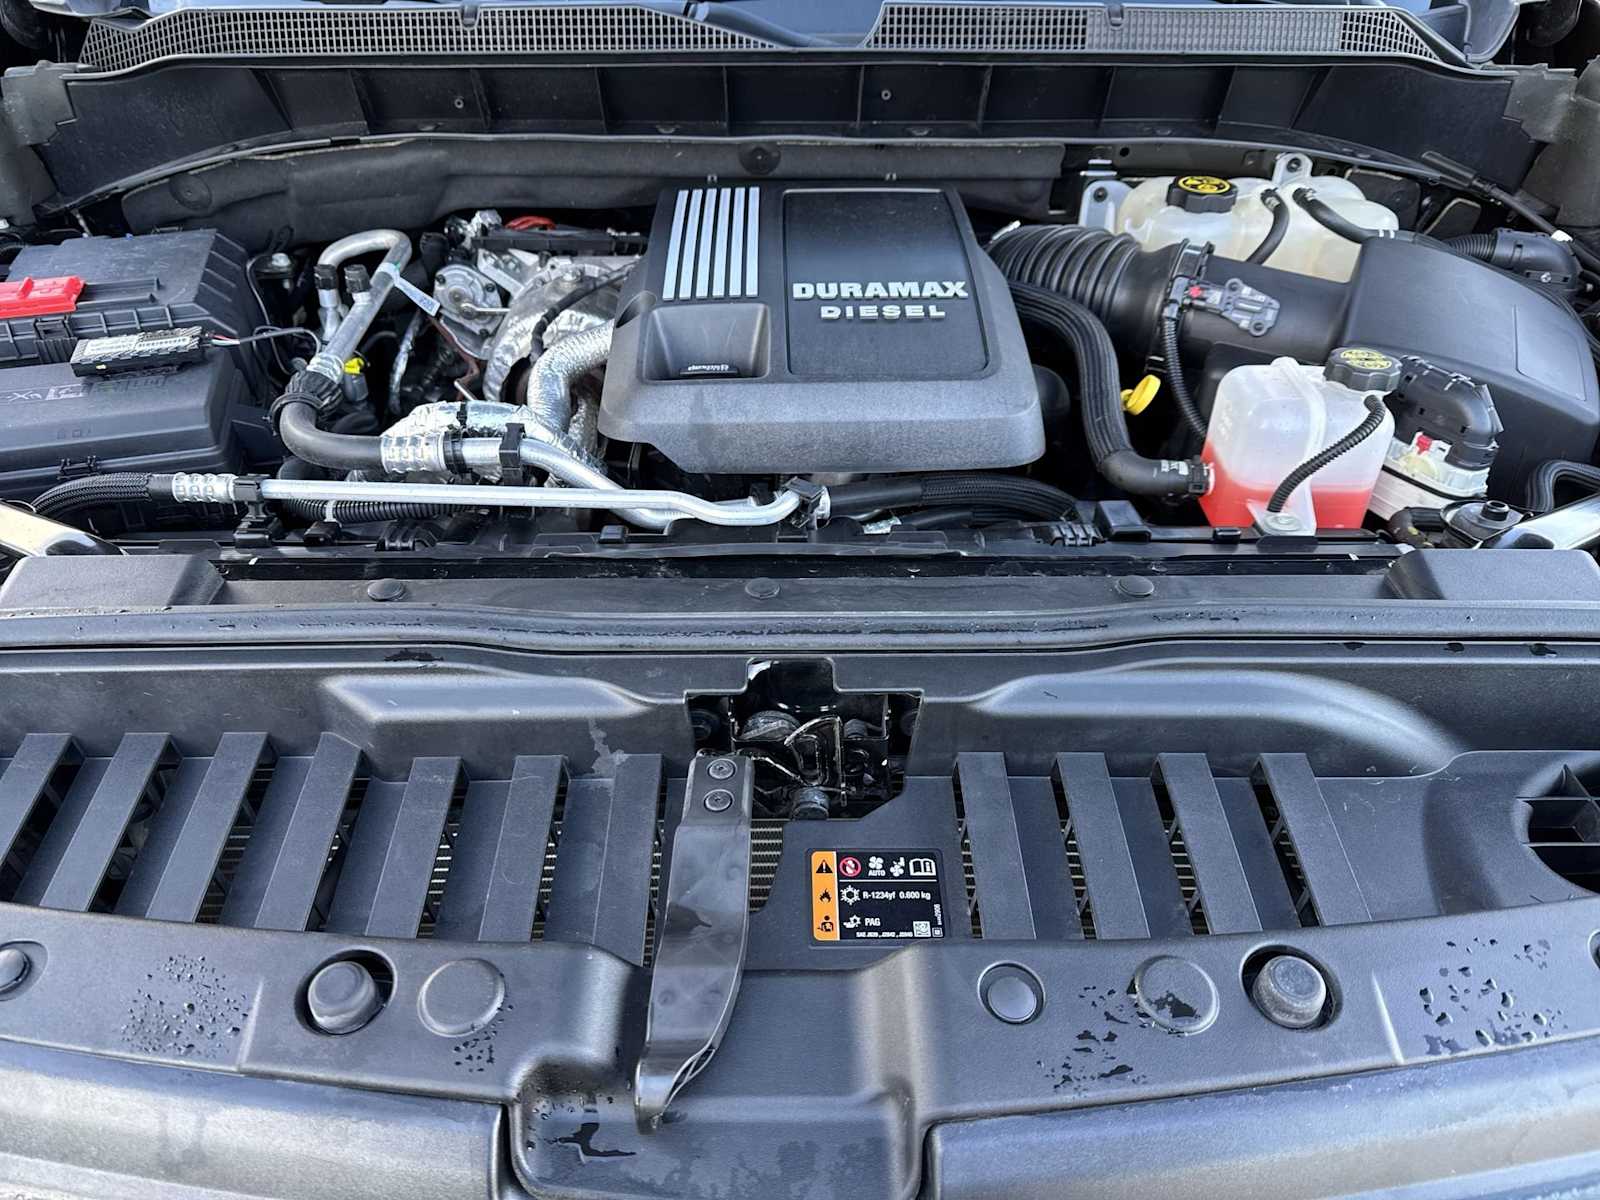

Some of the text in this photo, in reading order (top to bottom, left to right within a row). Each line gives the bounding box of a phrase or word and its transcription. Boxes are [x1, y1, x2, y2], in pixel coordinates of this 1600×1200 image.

[793, 281, 968, 299] DURAMAX
[820, 304, 946, 320] DIESEL
[868, 869, 886, 877] AUTO
[862, 890, 896, 901] R-1234yf
[921, 890, 931, 901] kg
[865, 917, 881, 926] PAG
